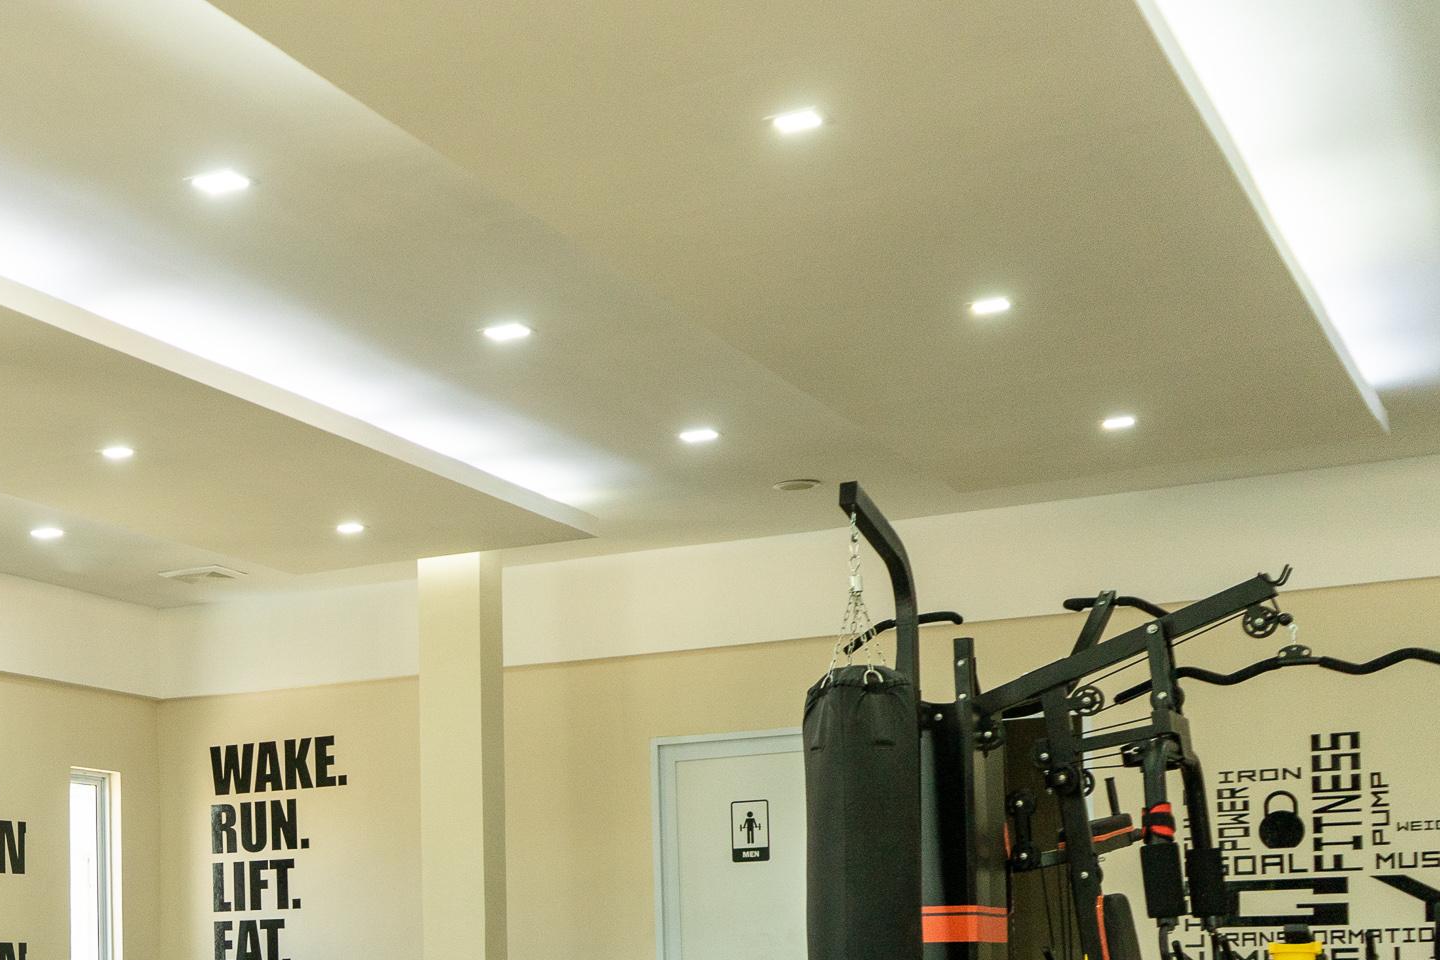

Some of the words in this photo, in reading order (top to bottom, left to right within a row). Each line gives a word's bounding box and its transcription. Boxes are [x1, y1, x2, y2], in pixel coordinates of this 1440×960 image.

[209, 735, 348, 796] WAKE.
[1218, 767, 1302, 784] IRON
[210, 798, 310, 854] RUN.
[1216, 786, 1251, 851] POWER
[1311, 731, 1363, 872] FITNESS
[1370, 772, 1391, 846] PUMP
[1396, 820, 1440, 832] WEI
[212, 858, 302, 913] LIFT.
